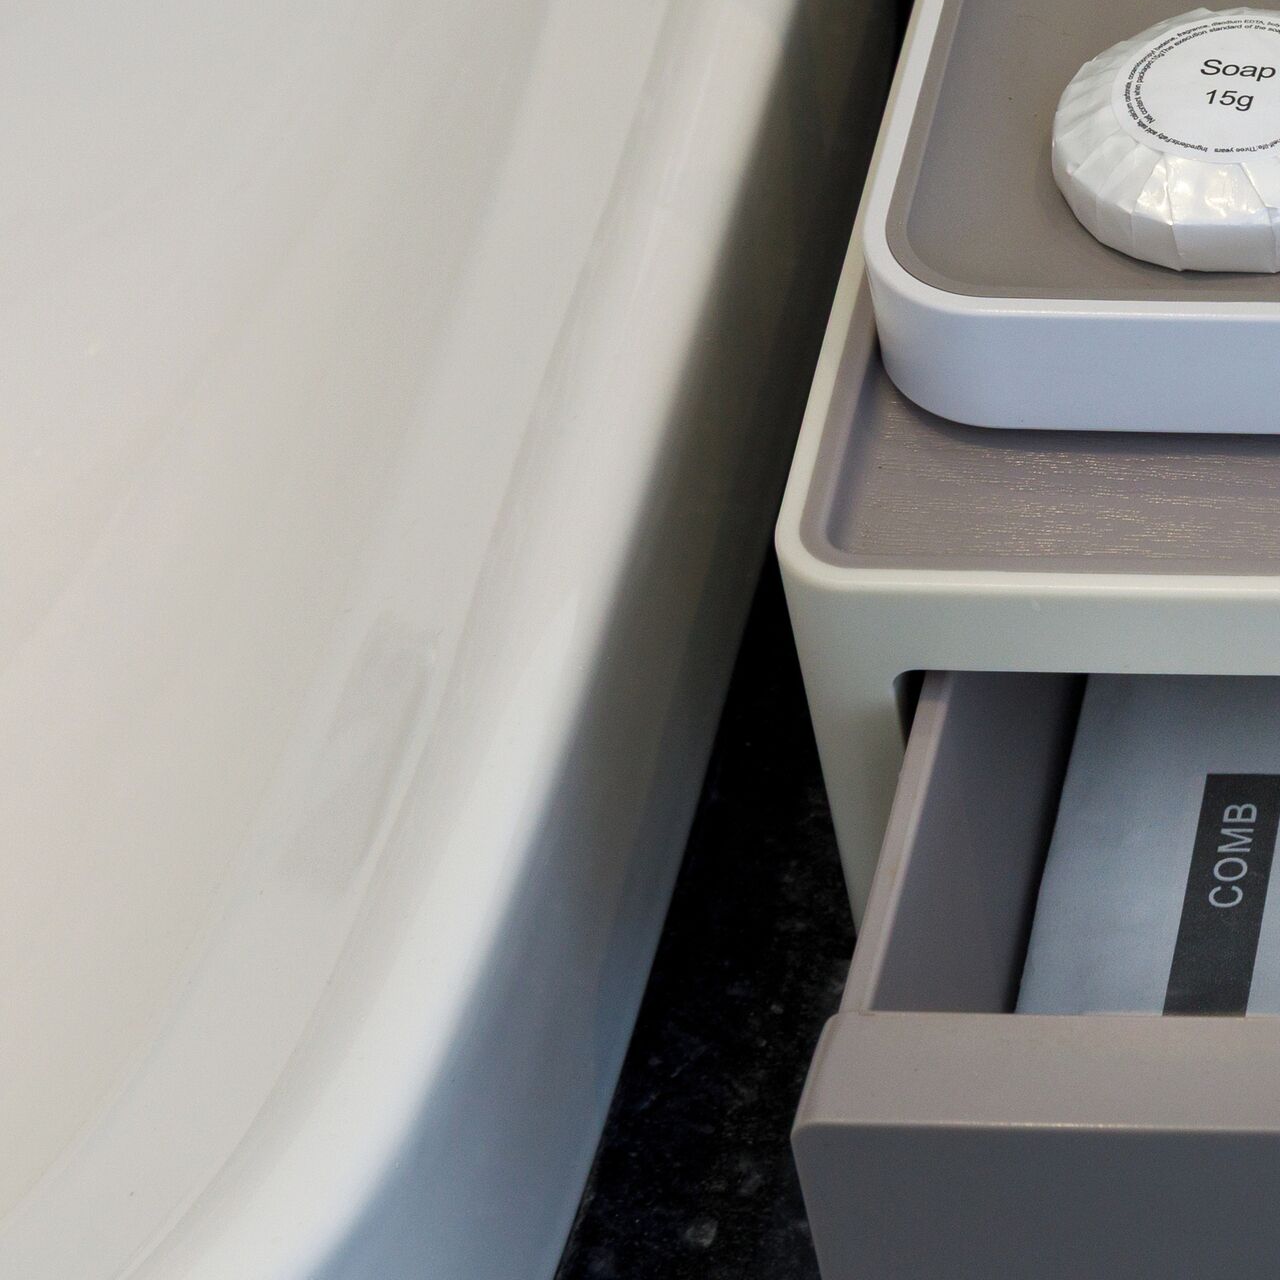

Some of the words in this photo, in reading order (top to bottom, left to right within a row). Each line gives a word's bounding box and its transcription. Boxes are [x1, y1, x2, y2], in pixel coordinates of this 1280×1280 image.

[1200, 59, 1276, 82] Soap
[1205, 89, 1254, 112] 15g
[1208, 802, 1258, 909] COMB
